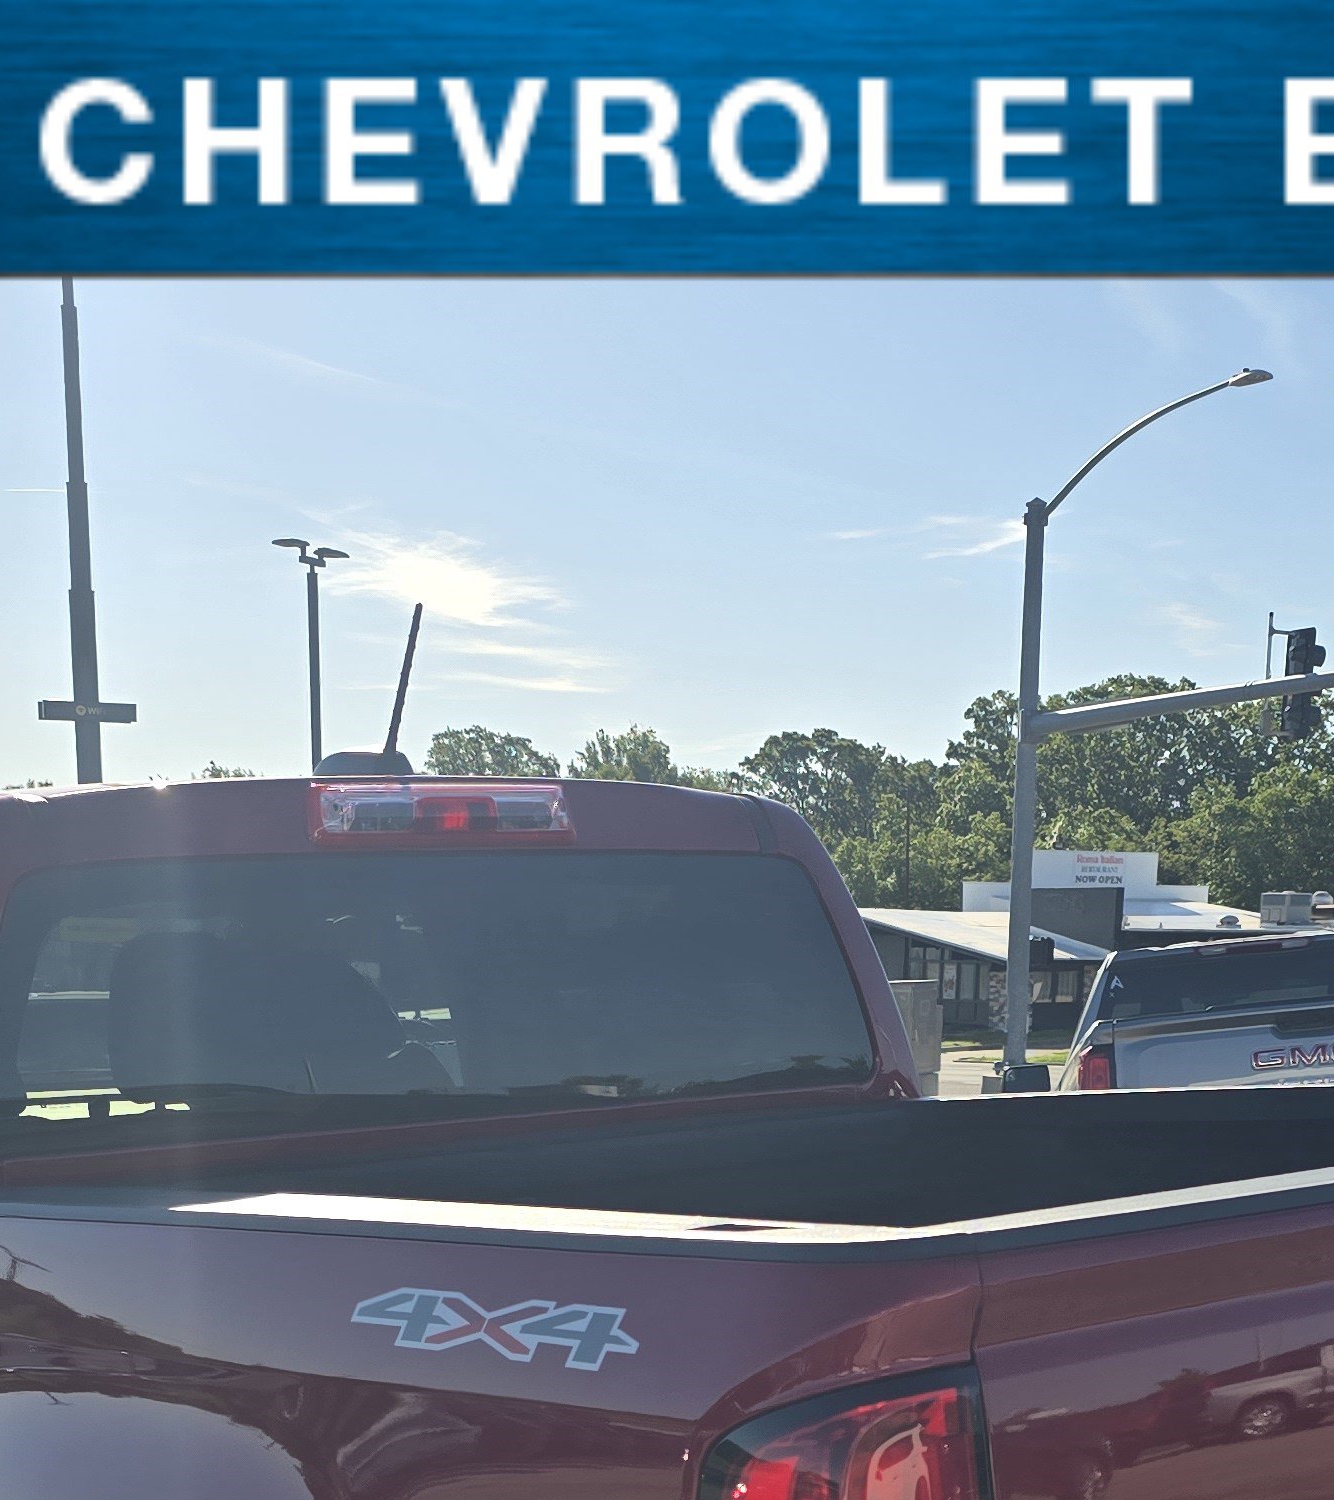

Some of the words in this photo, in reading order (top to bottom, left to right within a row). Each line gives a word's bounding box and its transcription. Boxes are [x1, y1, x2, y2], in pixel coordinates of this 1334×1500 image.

[1076, 854, 1099, 864] Roma
[1075, 875, 1097, 884] NOW
[1098, 875, 1123, 884] OPEN
